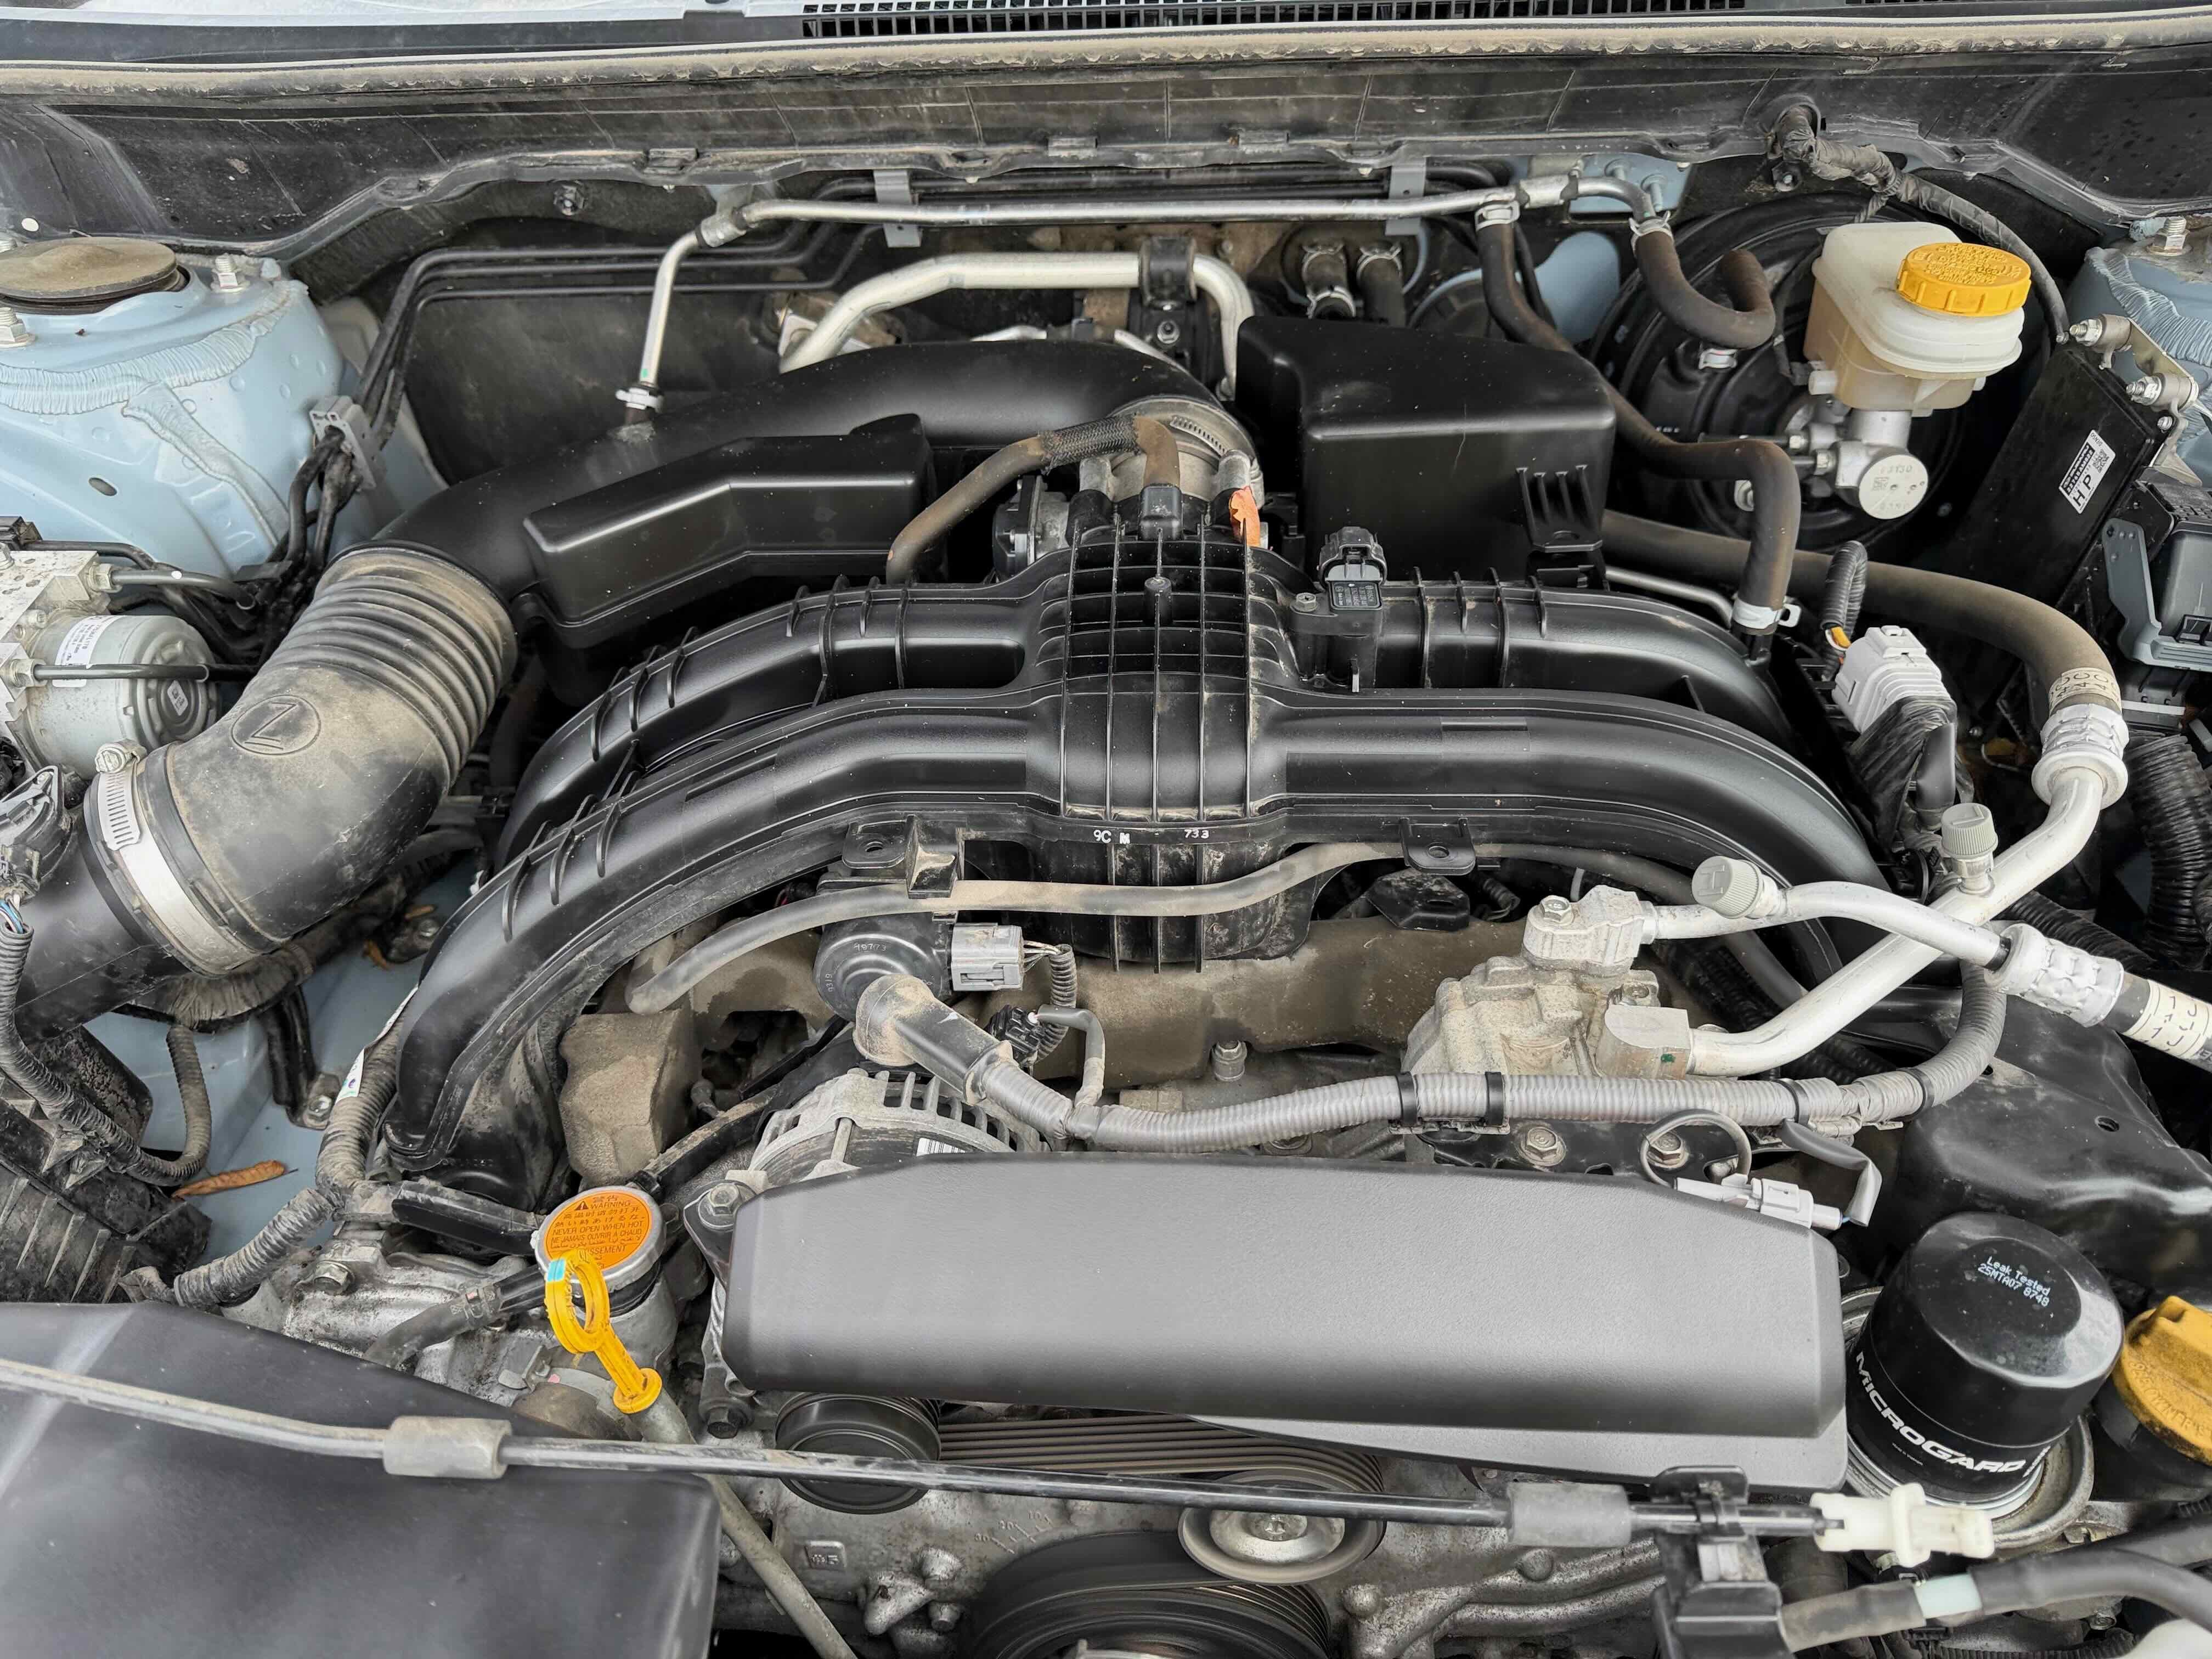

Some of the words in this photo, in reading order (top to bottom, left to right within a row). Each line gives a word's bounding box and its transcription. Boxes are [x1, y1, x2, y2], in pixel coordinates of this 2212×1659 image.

[1093, 829, 1112, 843] 9C
[591, 1200, 631, 1209] WARNING
[552, 1227, 577, 1235] NEVER
[580, 1224, 600, 1233] OPEN
[561, 1234, 585, 1243] JAMAIS
[588, 1232, 611, 1240] OUVRIR
[620, 1228, 642, 1237] CHAUD
[1987, 1256, 2012, 1276] Leak
[2016, 1270, 2051, 1296] Tested
[1977, 1263, 2023, 1291] 25MTA07
[2023, 1287, 2050, 1307] 8748
[1856, 1351, 2026, 1472] MICROGARD
